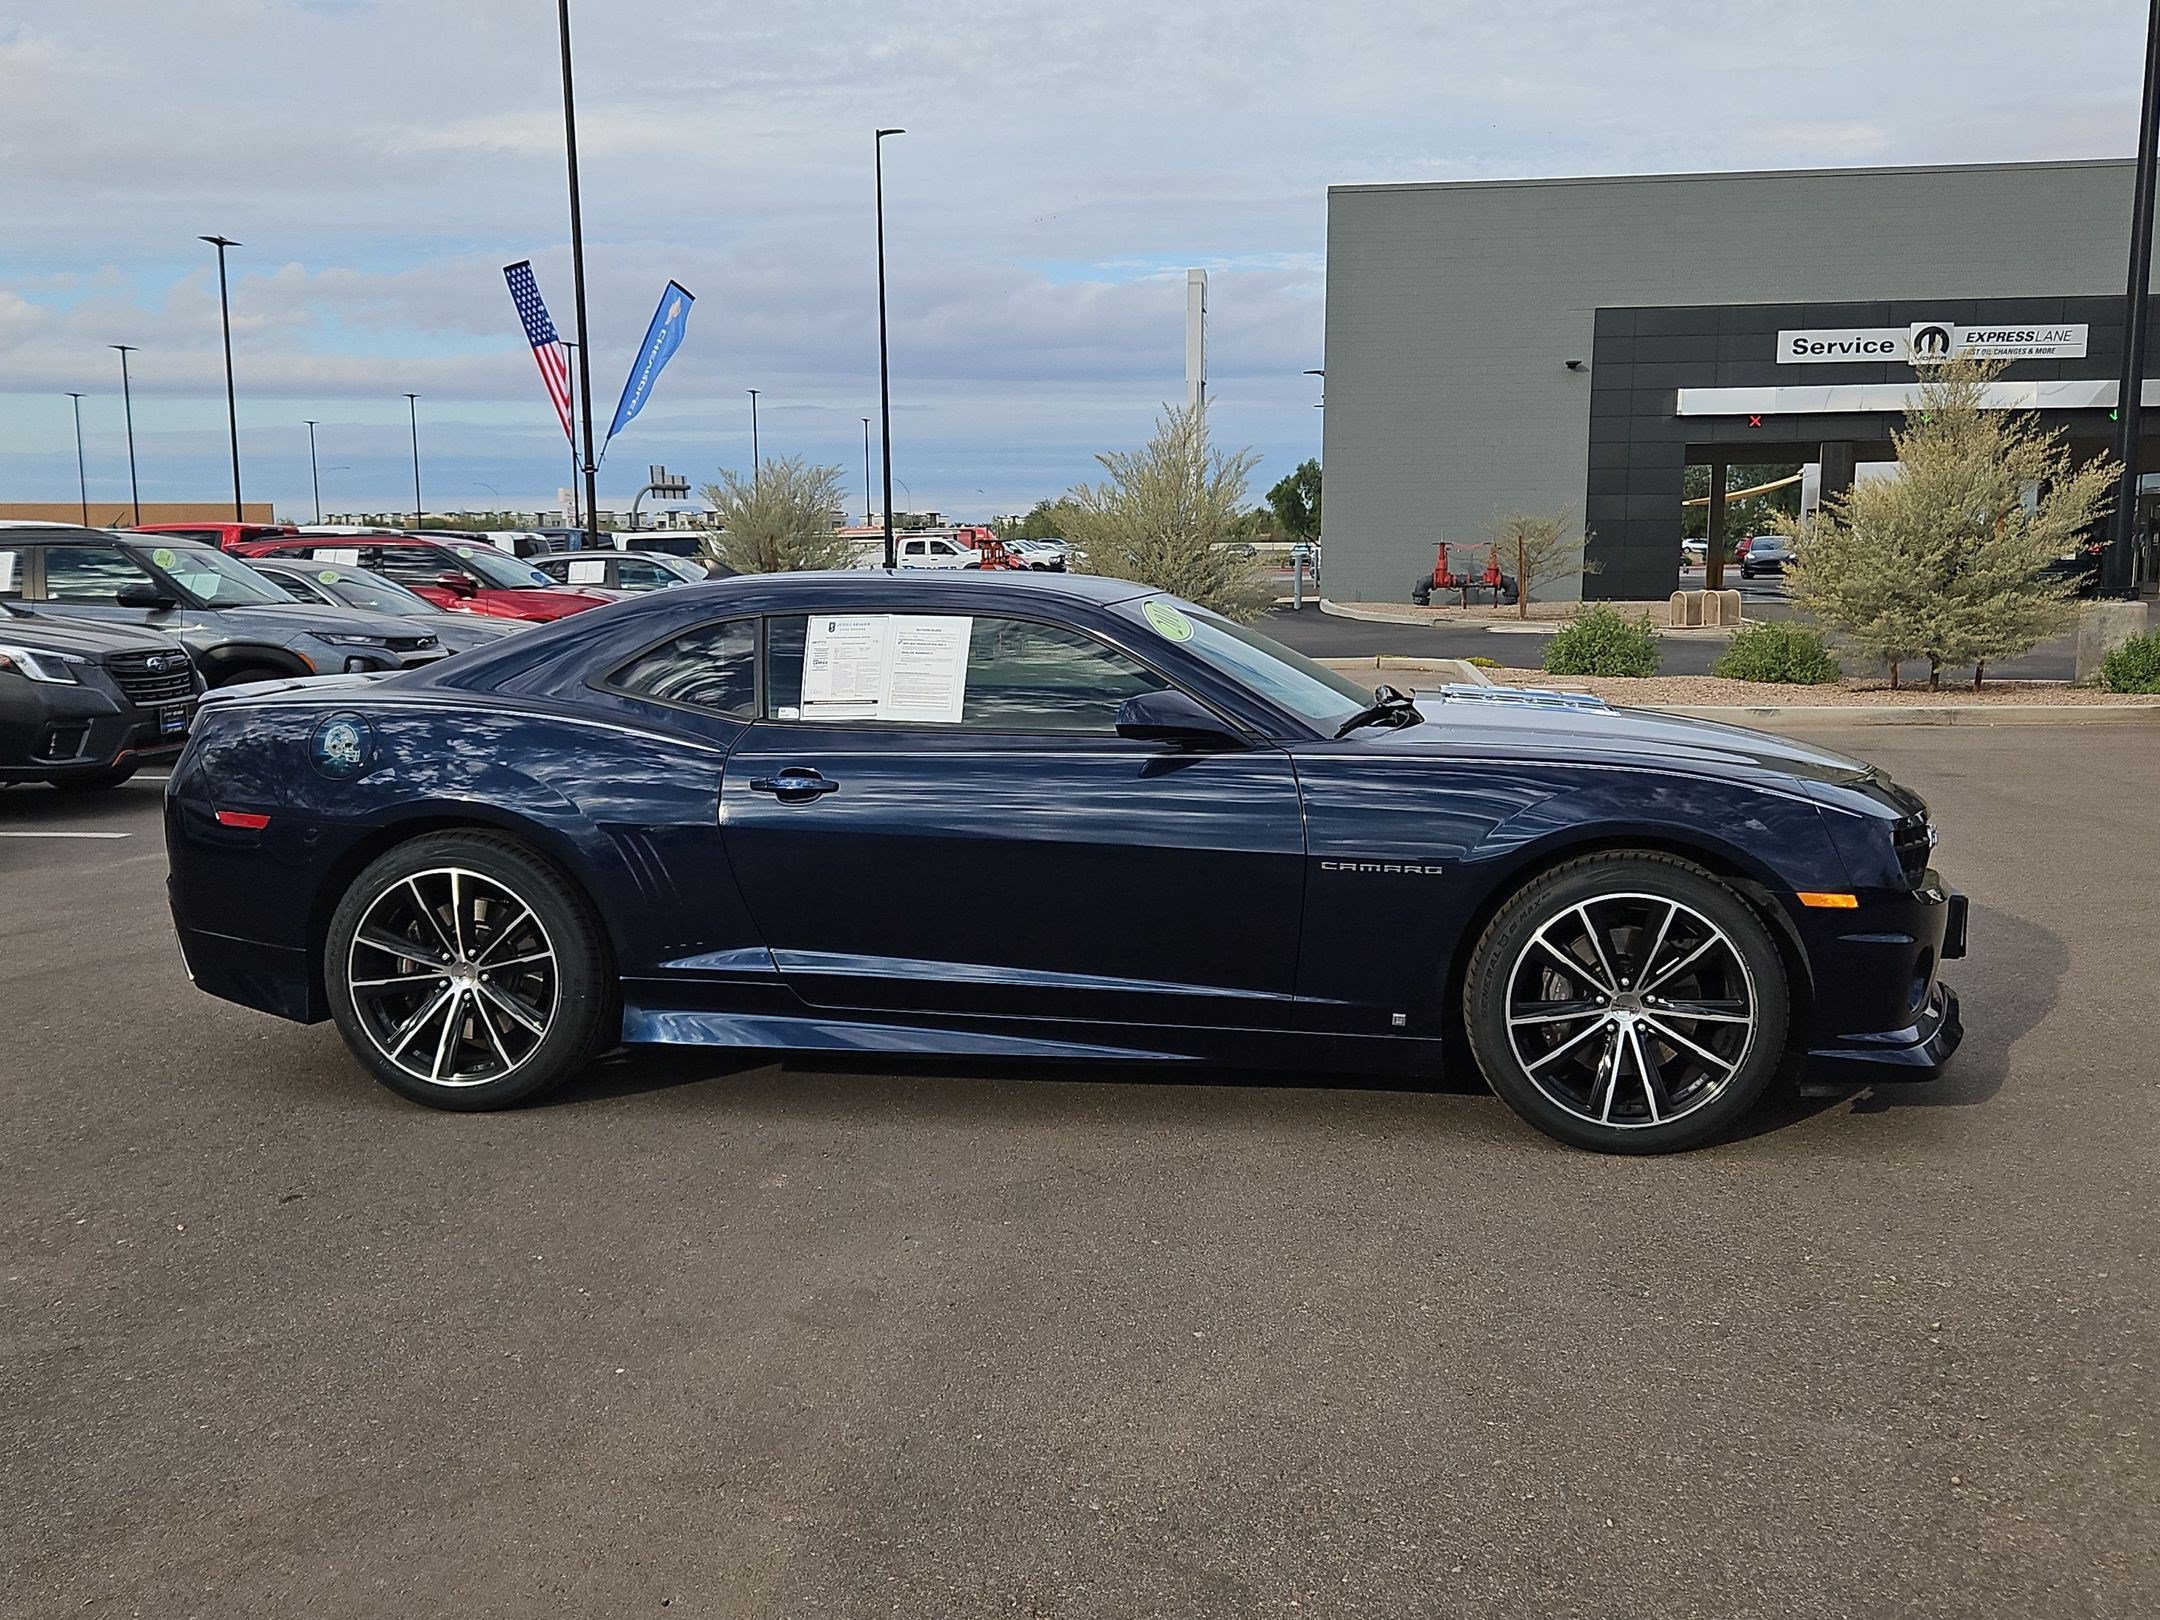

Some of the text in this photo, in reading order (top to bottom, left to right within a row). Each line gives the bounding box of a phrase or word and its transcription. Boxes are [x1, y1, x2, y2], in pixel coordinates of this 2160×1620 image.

[1966, 329, 2073, 343] EXPRESSLANE
[1791, 336, 1895, 355] Service
[1993, 347, 2027, 355] CHANGES
[2035, 347, 2057, 355] MORE
[1321, 861, 1443, 875] CAMARO
